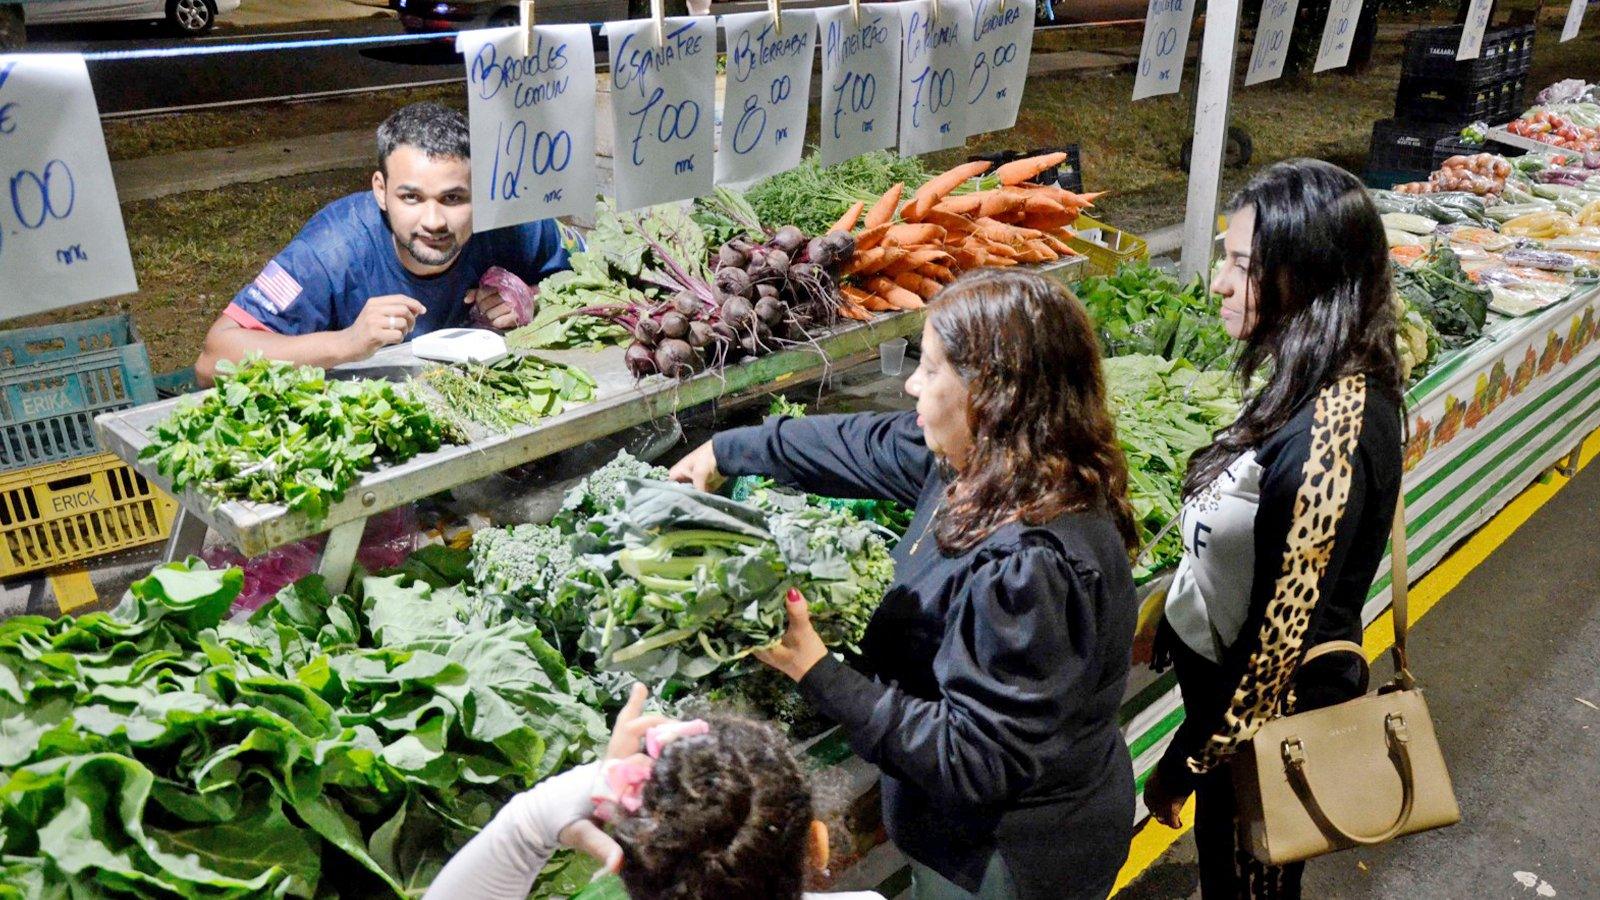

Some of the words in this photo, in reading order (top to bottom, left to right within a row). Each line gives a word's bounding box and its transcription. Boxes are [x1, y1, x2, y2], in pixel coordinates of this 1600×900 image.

[490, 121, 571, 200] 12.00
[23, 390, 72, 415] ERIKA
[52, 489, 100, 513] ERICK
